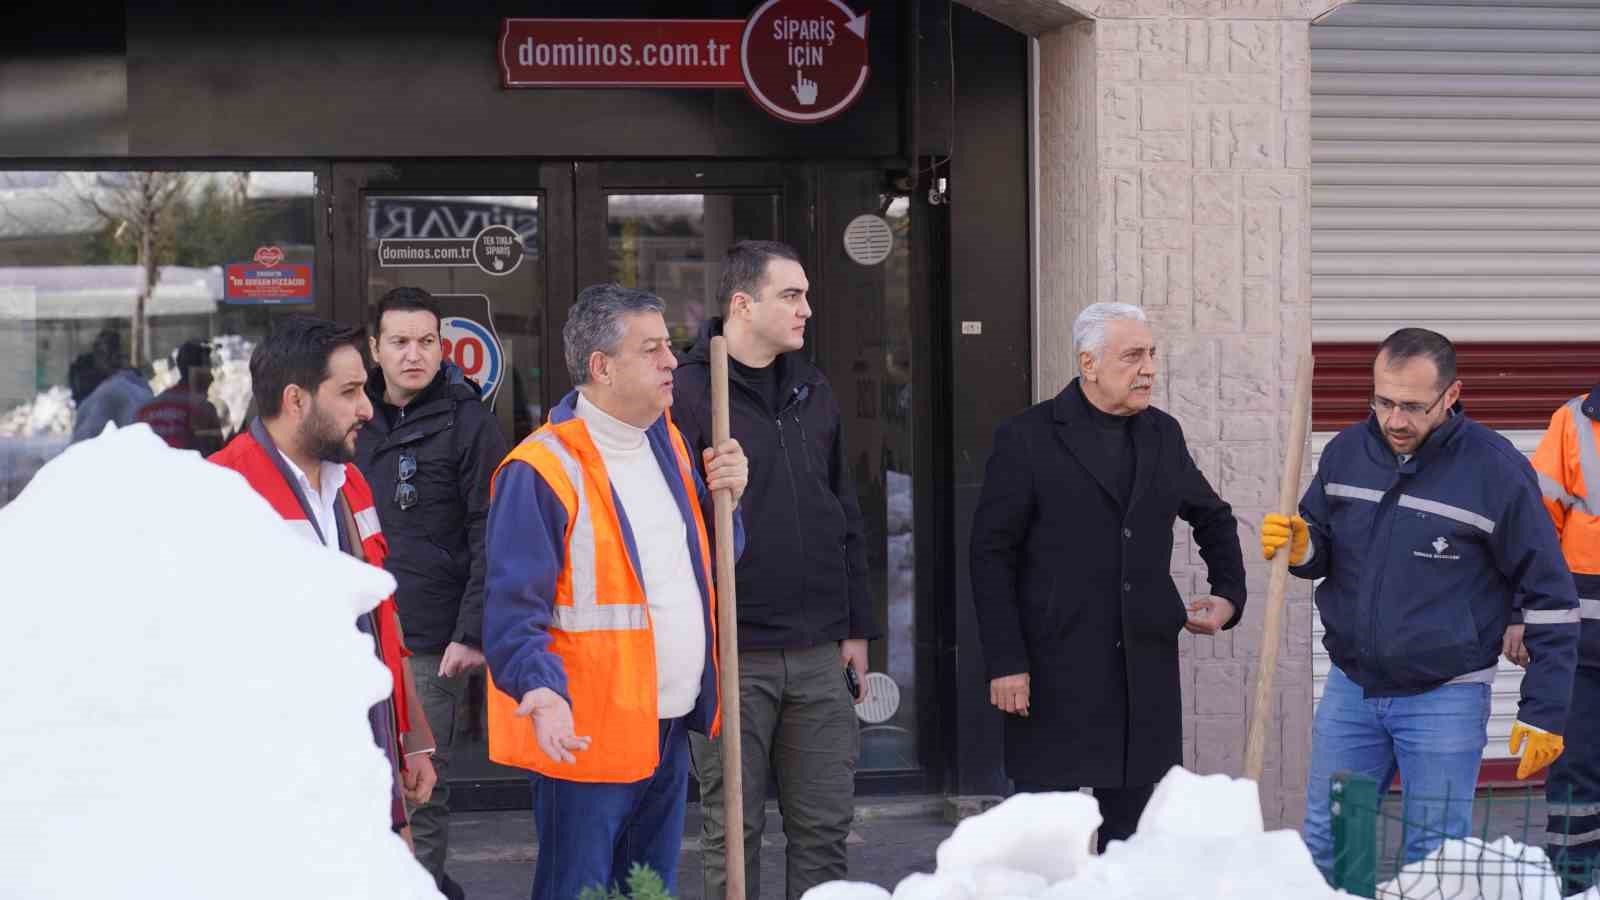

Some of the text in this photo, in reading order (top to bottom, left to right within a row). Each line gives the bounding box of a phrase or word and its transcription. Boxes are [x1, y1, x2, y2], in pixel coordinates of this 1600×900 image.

[773, 16, 835, 46] SİPARİŞ
[518, 36, 731, 67] dominos.com.tr
[382, 246, 472, 260] dominos.com.tr
